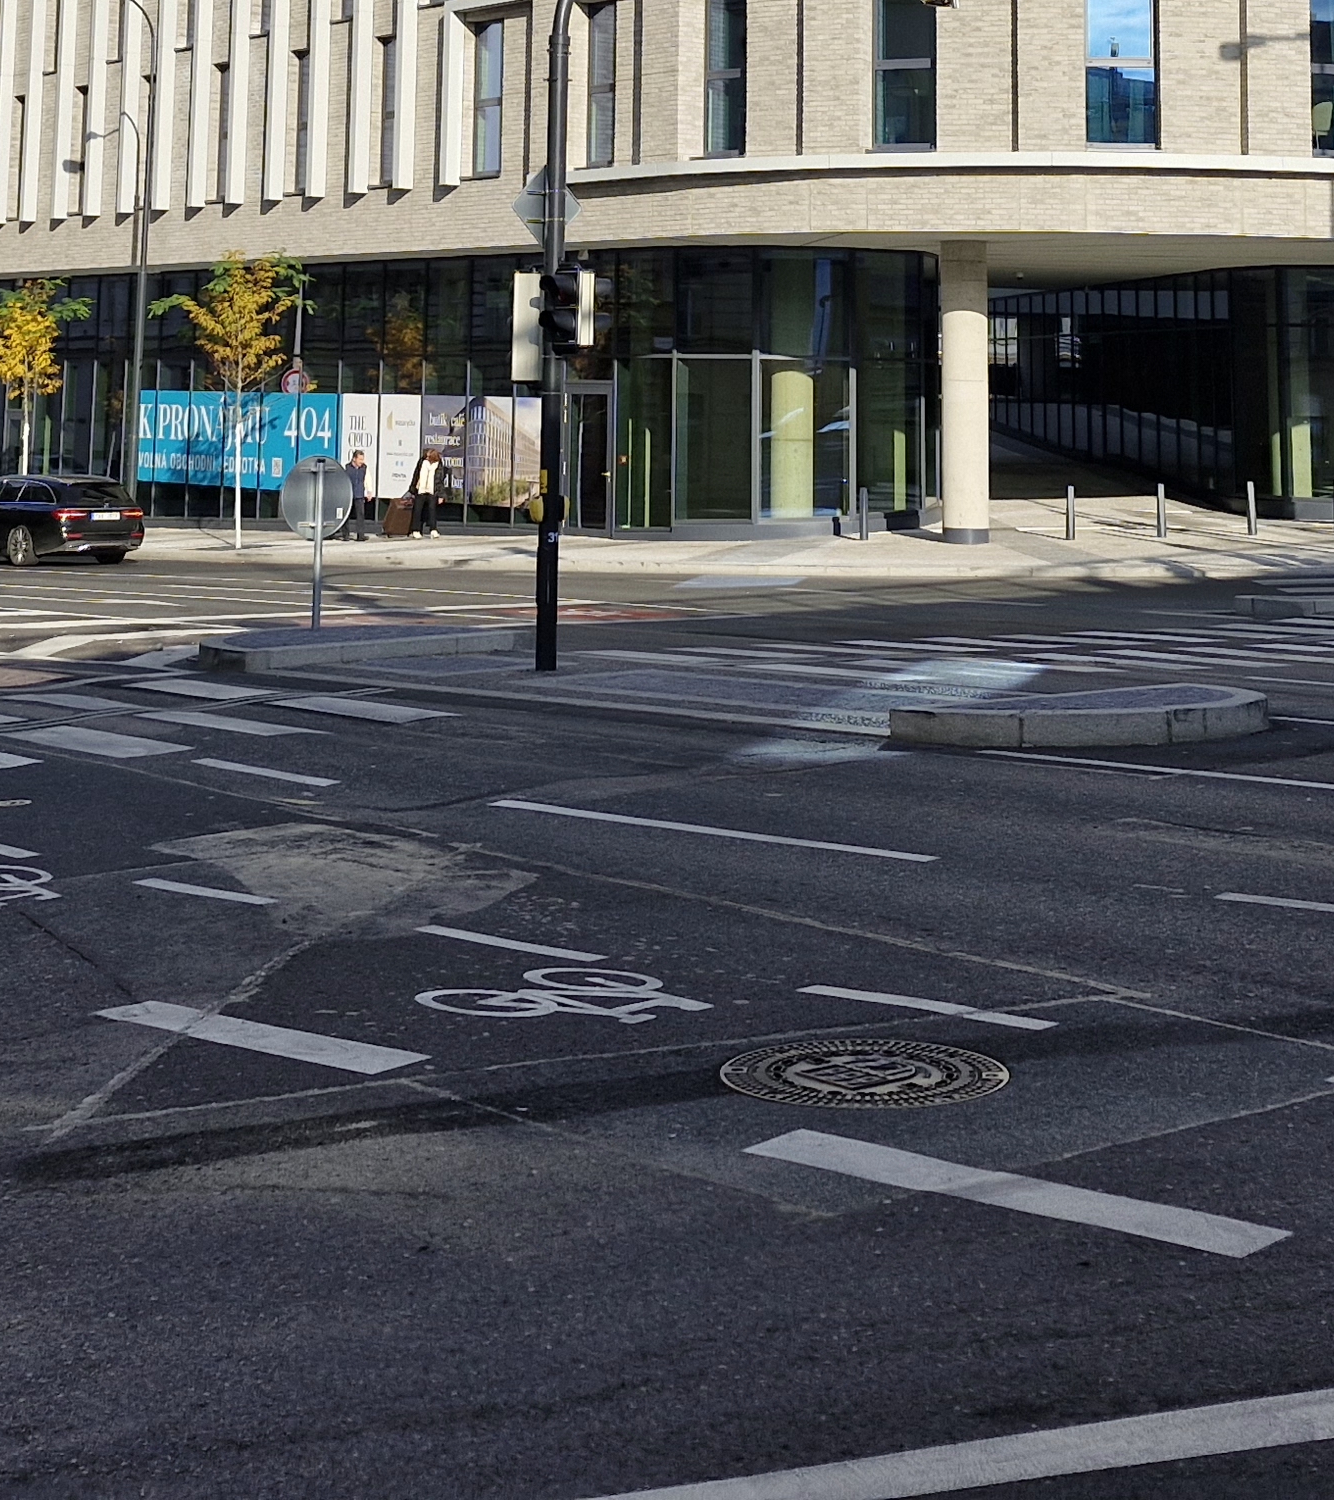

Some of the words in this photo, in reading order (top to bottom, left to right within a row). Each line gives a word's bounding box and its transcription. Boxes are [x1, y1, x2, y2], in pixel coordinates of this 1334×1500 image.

[138, 403, 153, 439] K
[283, 406, 332, 449] 404
[349, 415, 367, 431] THE
[348, 431, 373, 448] CLOUD
[138, 449, 168, 469] VOLNÁ
[170, 451, 216, 473] OBCHODNÍ
[548, 531, 559, 543] 31
